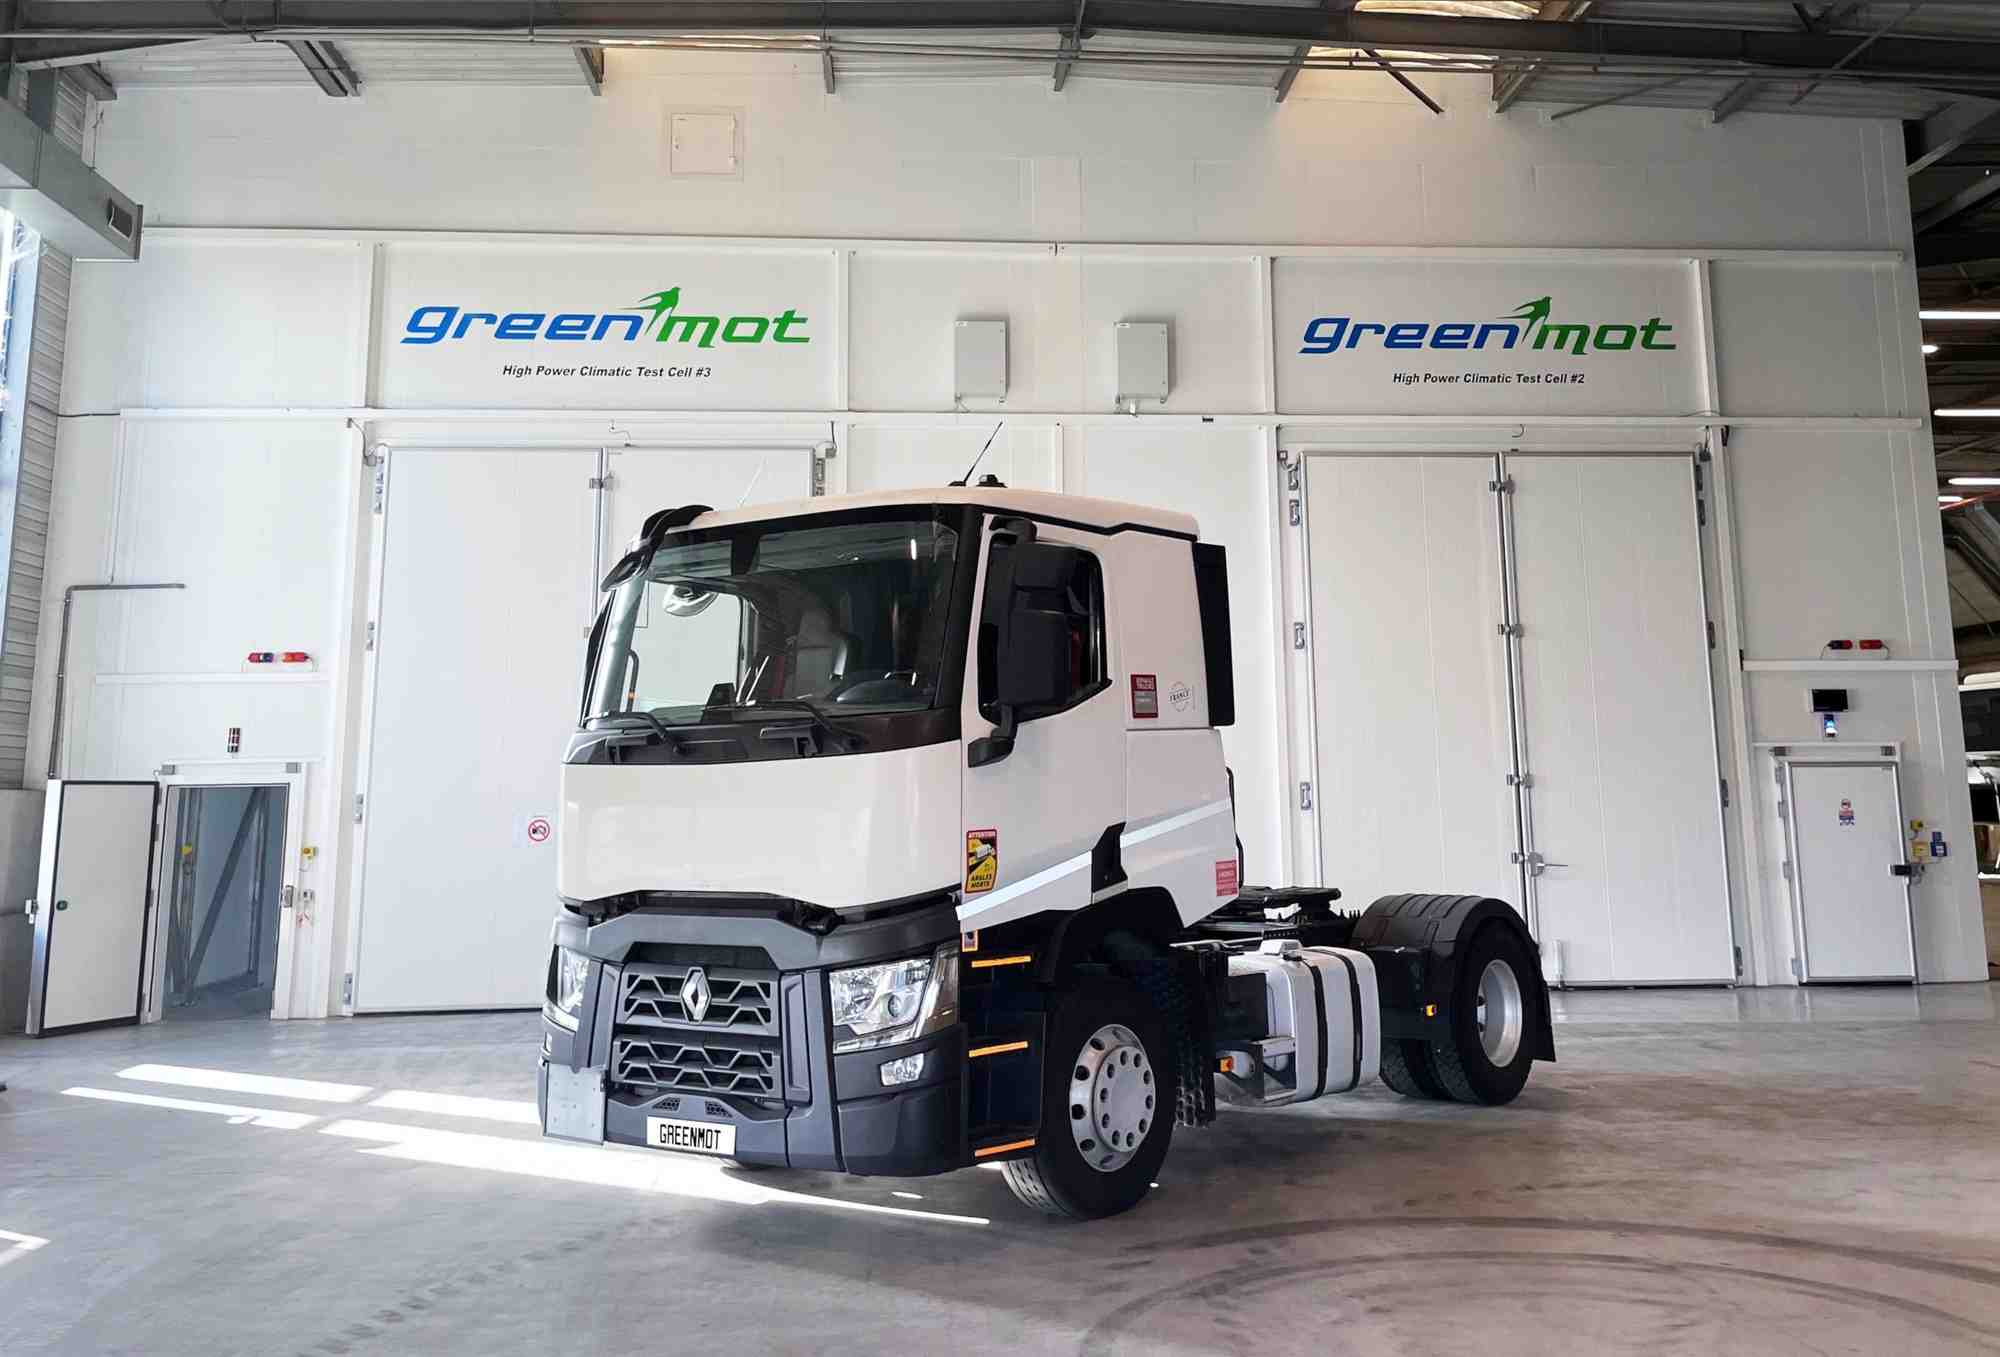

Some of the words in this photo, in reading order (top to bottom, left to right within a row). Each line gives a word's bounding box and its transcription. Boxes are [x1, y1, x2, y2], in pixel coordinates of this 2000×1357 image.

[502, 365, 532, 379] High
[535, 365, 577, 377] Power
[579, 365, 633, 377] Climatic
[638, 366, 664, 378] Test
[668, 366, 693, 378] Cell
[695, 367, 712, 378] #3
[1393, 373, 1420, 386] High
[1423, 373, 1460, 384] Power
[1463, 373, 1513, 384] Climatic
[1516, 373, 1541, 384] Test
[1544, 373, 1568, 384] Cell
[1570, 373, 1586, 384] #2
[660, 1124, 721, 1150] GREENMOT
